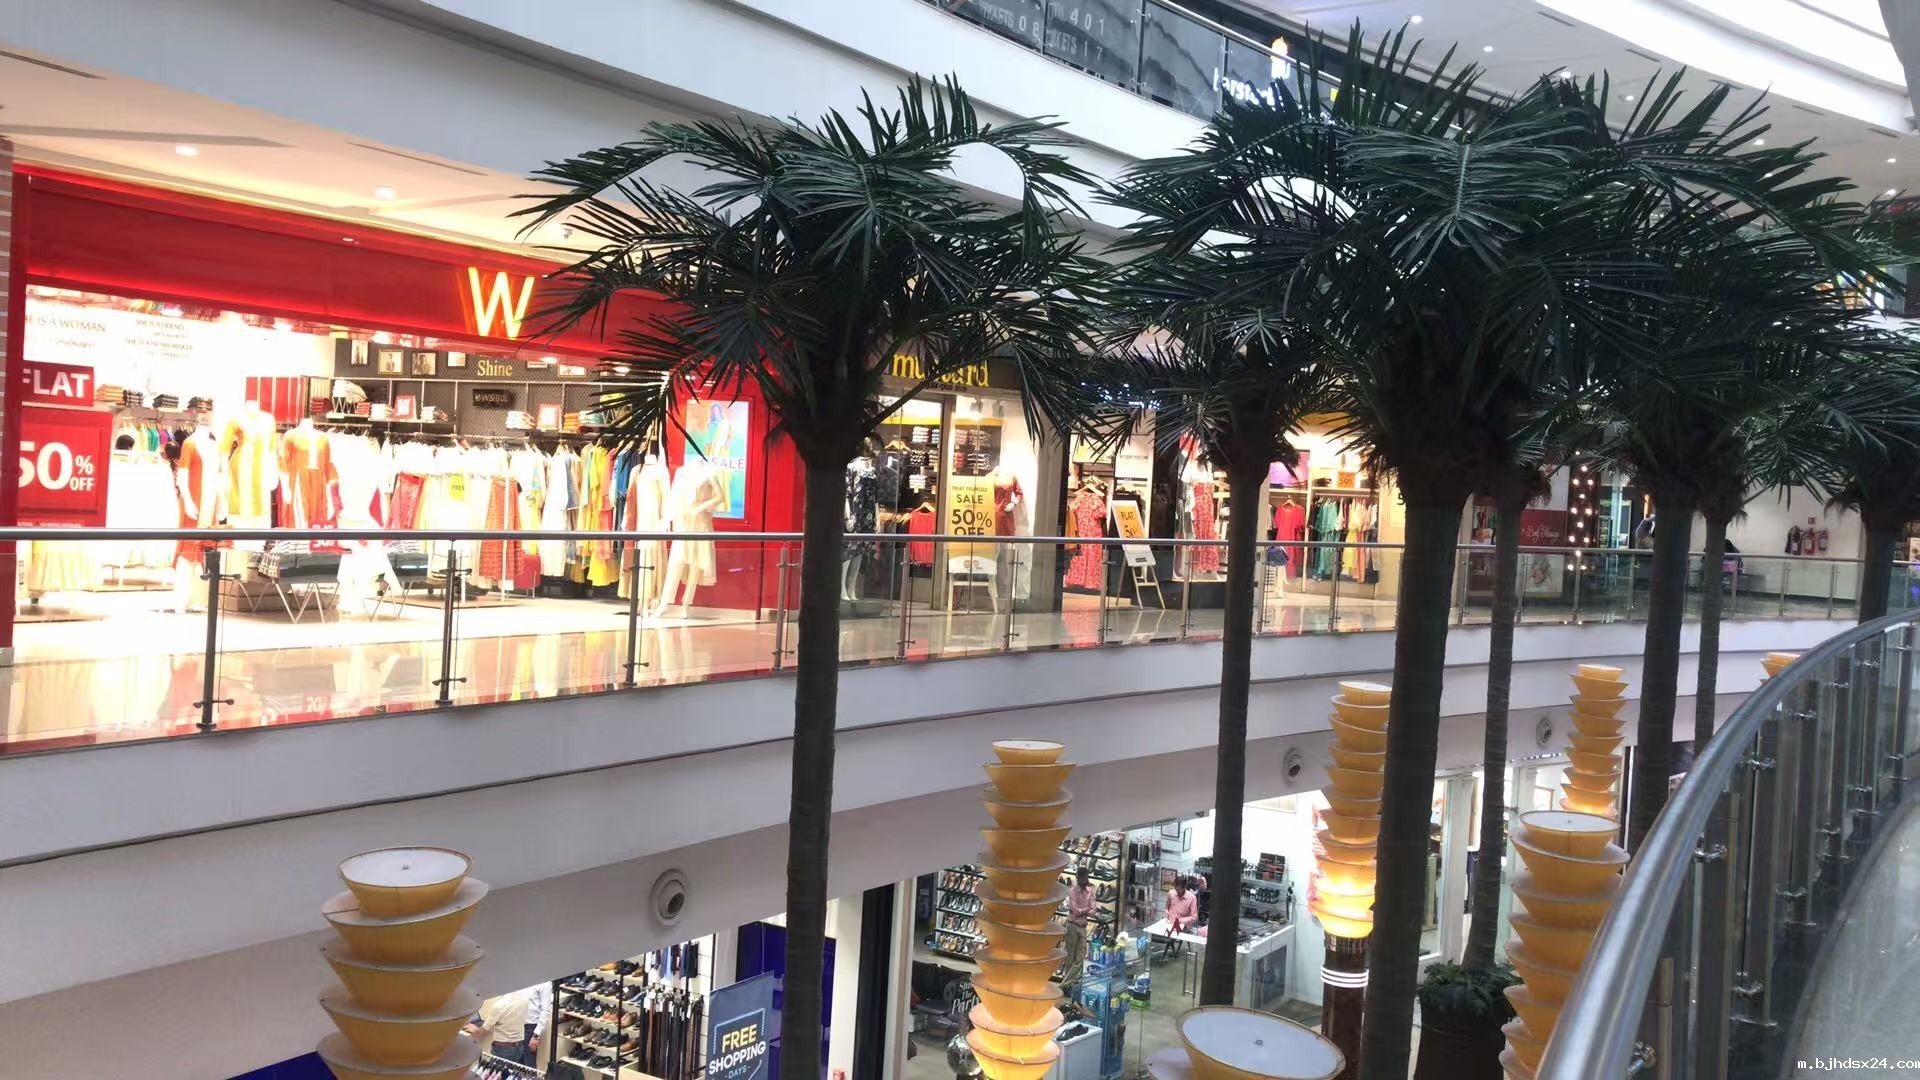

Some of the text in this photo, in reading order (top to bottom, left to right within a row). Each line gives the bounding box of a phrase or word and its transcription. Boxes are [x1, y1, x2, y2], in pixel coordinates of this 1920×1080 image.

[467, 266, 535, 340] W
[477, 359, 513, 376] Shine
[892, 353, 990, 388] muard
[711, 457, 745, 469] SALE
[69, 477, 94, 491] OFF
[956, 494, 984, 505] SALE
[952, 508, 993, 528] 50%
[721, 1023, 758, 1054] FREE
[708, 1040, 767, 1075] SHOPPING
